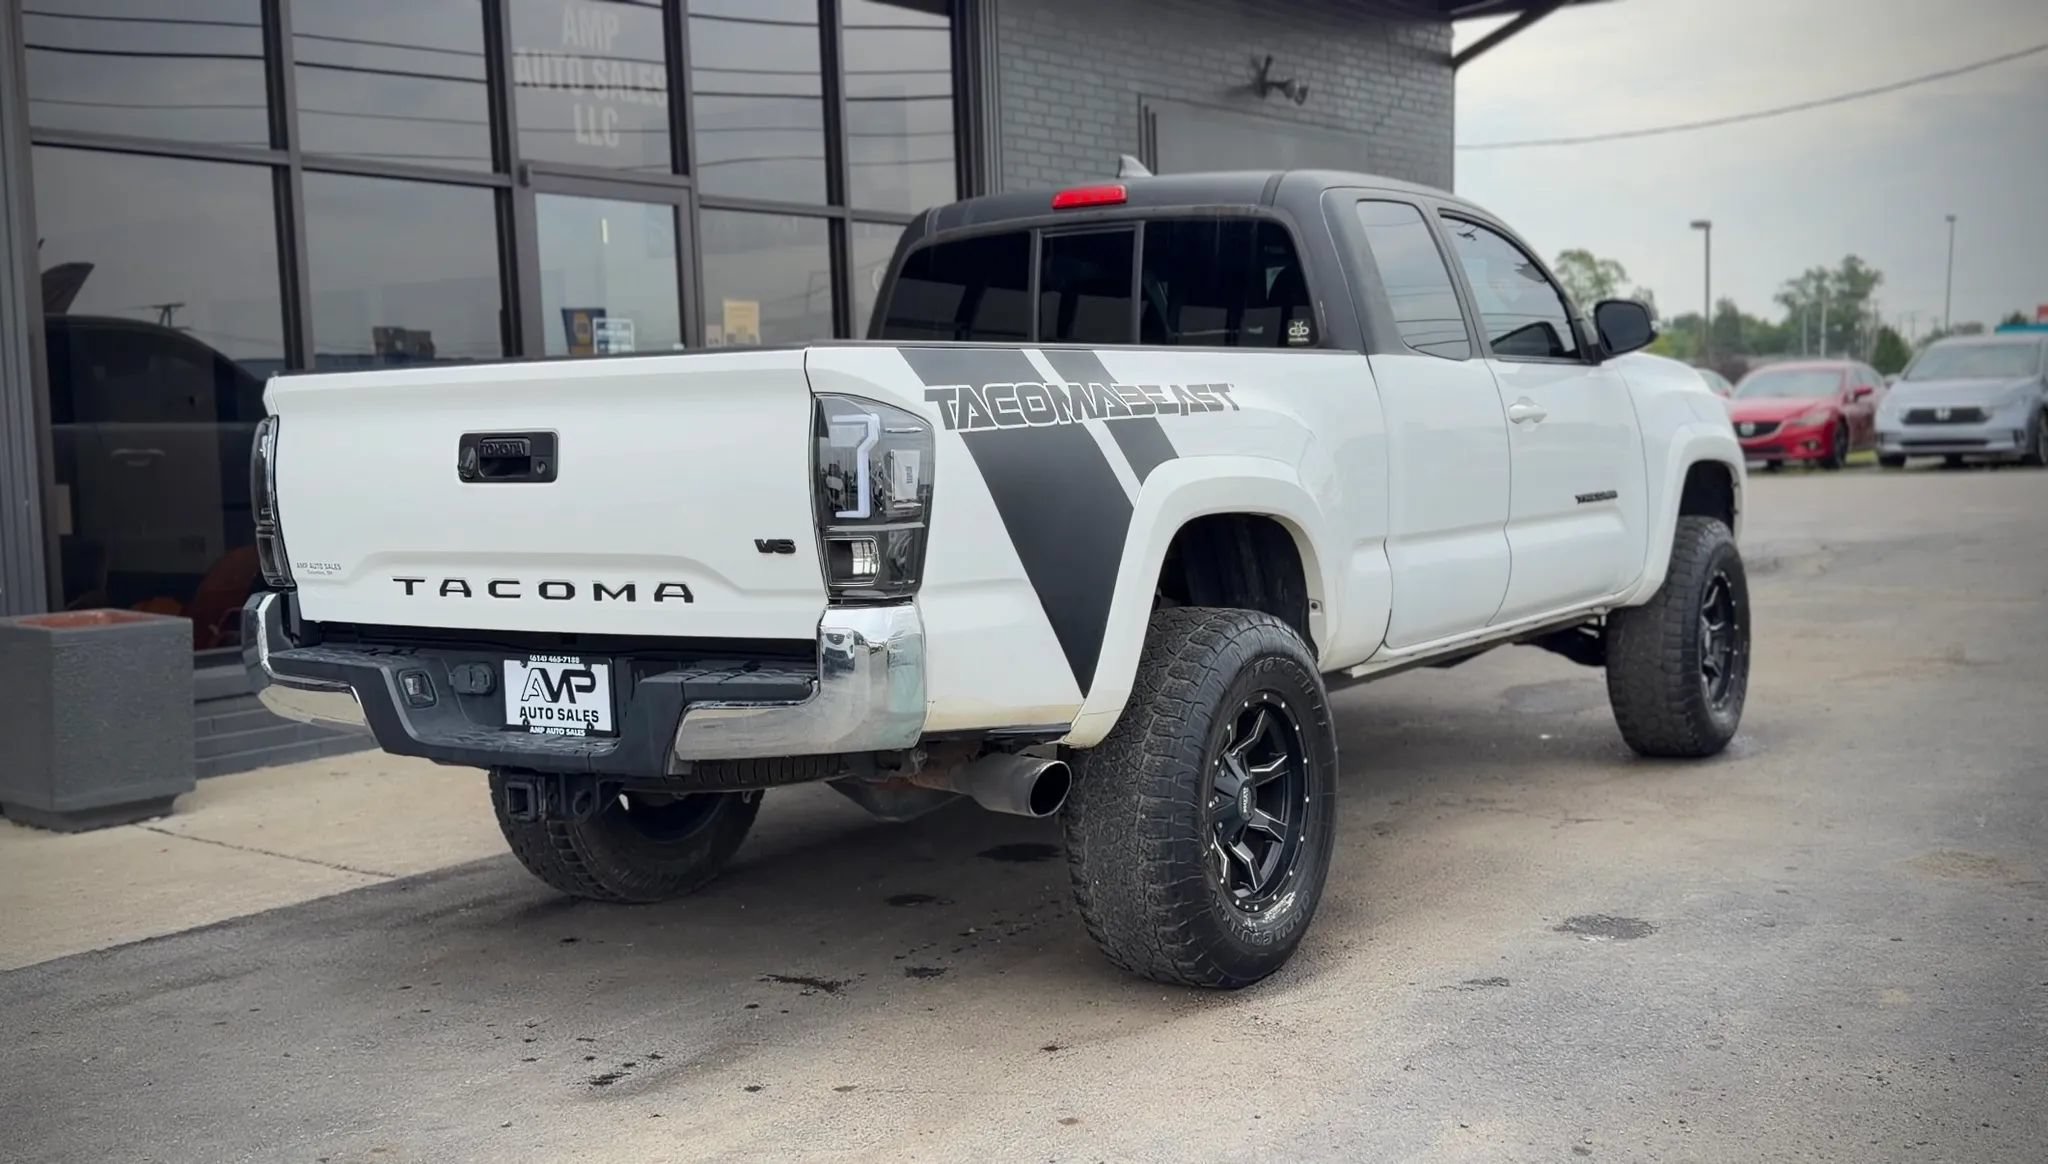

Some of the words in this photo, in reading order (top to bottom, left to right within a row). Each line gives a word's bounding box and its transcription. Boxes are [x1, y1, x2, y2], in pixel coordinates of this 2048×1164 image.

[562, 4, 619, 52] AMP
[512, 49, 585, 97] AUTO
[591, 58, 668, 108] SALES
[574, 103, 620, 148] LLC
[481, 442, 525, 456] TOYOTA
[754, 539, 796, 554] V6
[393, 576, 694, 603] TACOMA
[529, 655, 547, 663] (614)
[521, 667, 596, 704] AMP
[520, 706, 554, 720] AUTO
[558, 708, 599, 723] SALES
[529, 726, 545, 734] AMP
[546, 727, 564, 735] AUTO
[566, 728, 585, 737] SALES
